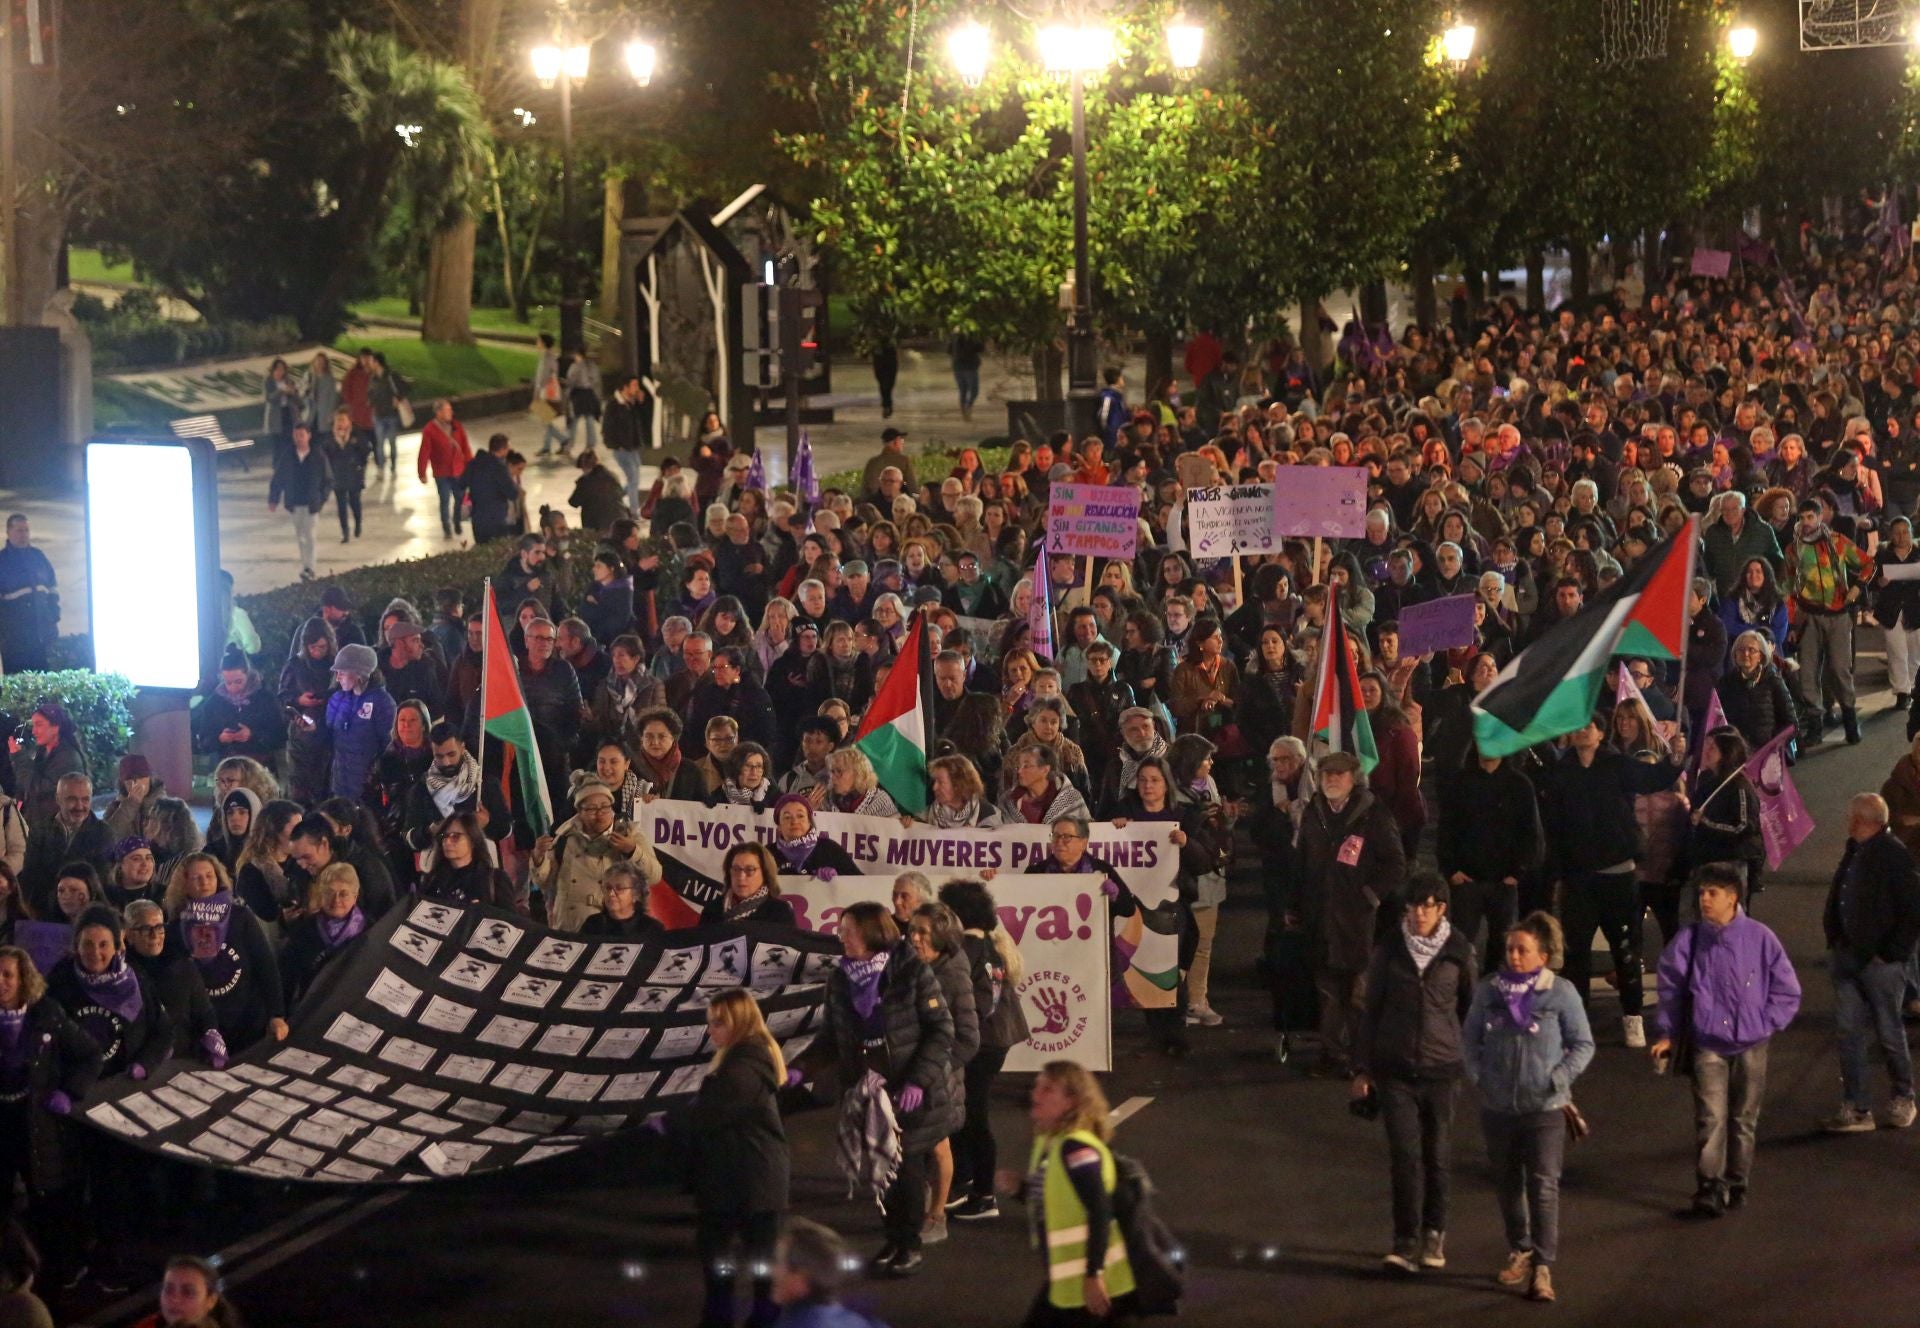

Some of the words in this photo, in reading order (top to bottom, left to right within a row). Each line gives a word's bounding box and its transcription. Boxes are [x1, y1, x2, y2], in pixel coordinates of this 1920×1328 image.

[1054, 487, 1074, 500] SIN
[1189, 487, 1221, 502] MUJER
[1051, 504, 1065, 516] NO
[1052, 519, 1070, 532] SIN
[1076, 520, 1126, 534] GITANAS
[1065, 533, 1120, 550] TAMPOCO
[841, 831, 879, 862] LES
[886, 837, 1003, 869] MUYERES
[1016, 969, 1071, 999] UJERES
[1071, 983, 1087, 1003] DE
